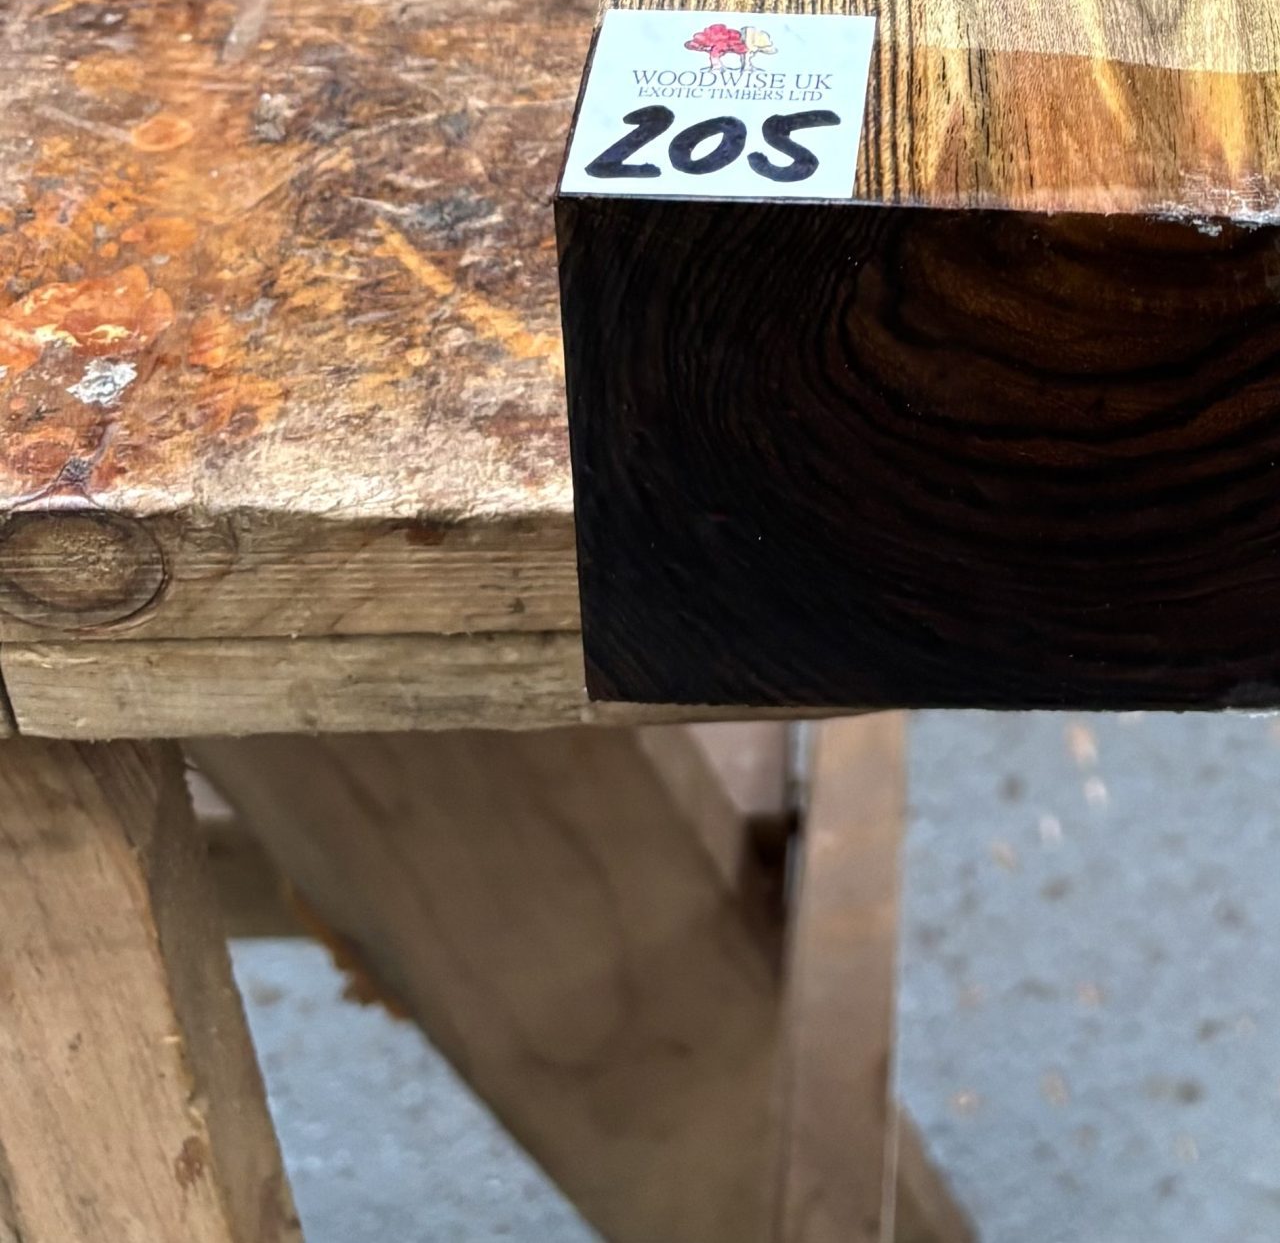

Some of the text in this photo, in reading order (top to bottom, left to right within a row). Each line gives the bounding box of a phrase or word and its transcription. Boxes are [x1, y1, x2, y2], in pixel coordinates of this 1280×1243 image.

[632, 70, 833, 90] WOODWISE UK
[638, 86, 823, 102] EXOTIC TIMBERS LTD
[584, 105, 841, 183] 205
